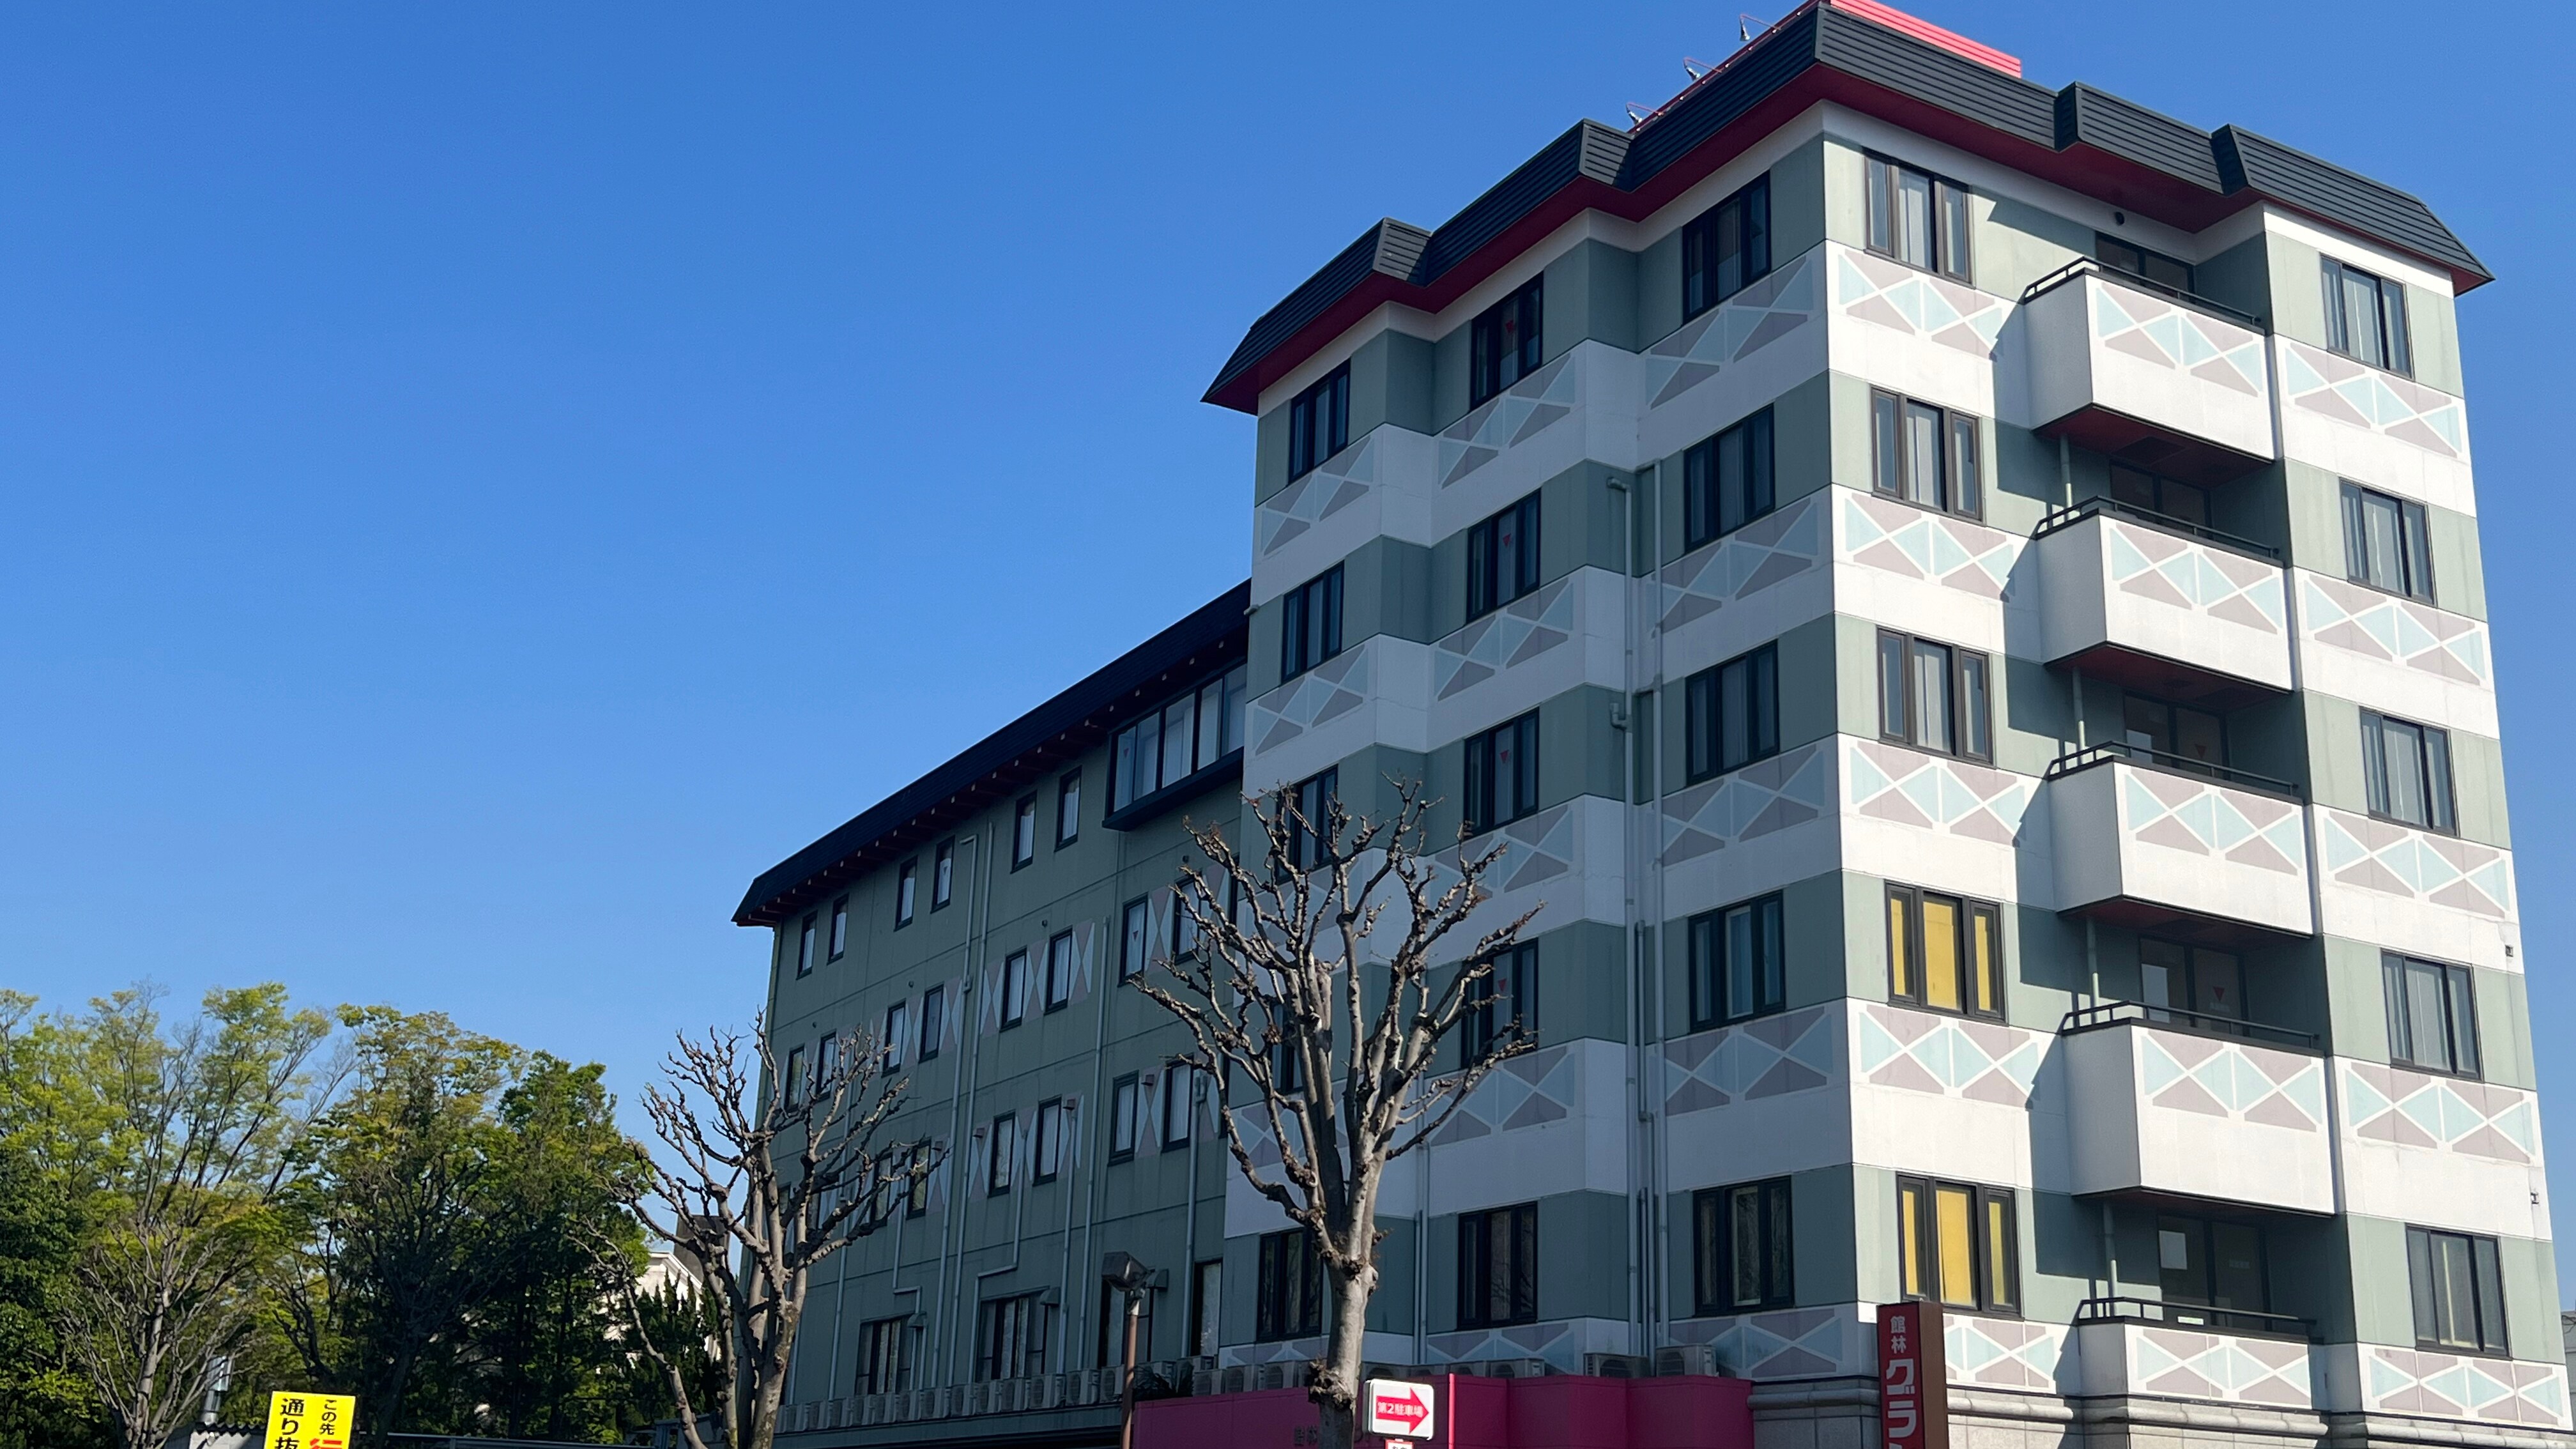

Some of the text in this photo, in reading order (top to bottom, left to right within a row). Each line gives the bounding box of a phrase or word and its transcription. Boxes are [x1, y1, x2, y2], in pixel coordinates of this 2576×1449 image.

[319, 1399, 337, 1435] この先
[1886, 1315, 1917, 1449] 館林 グラ
